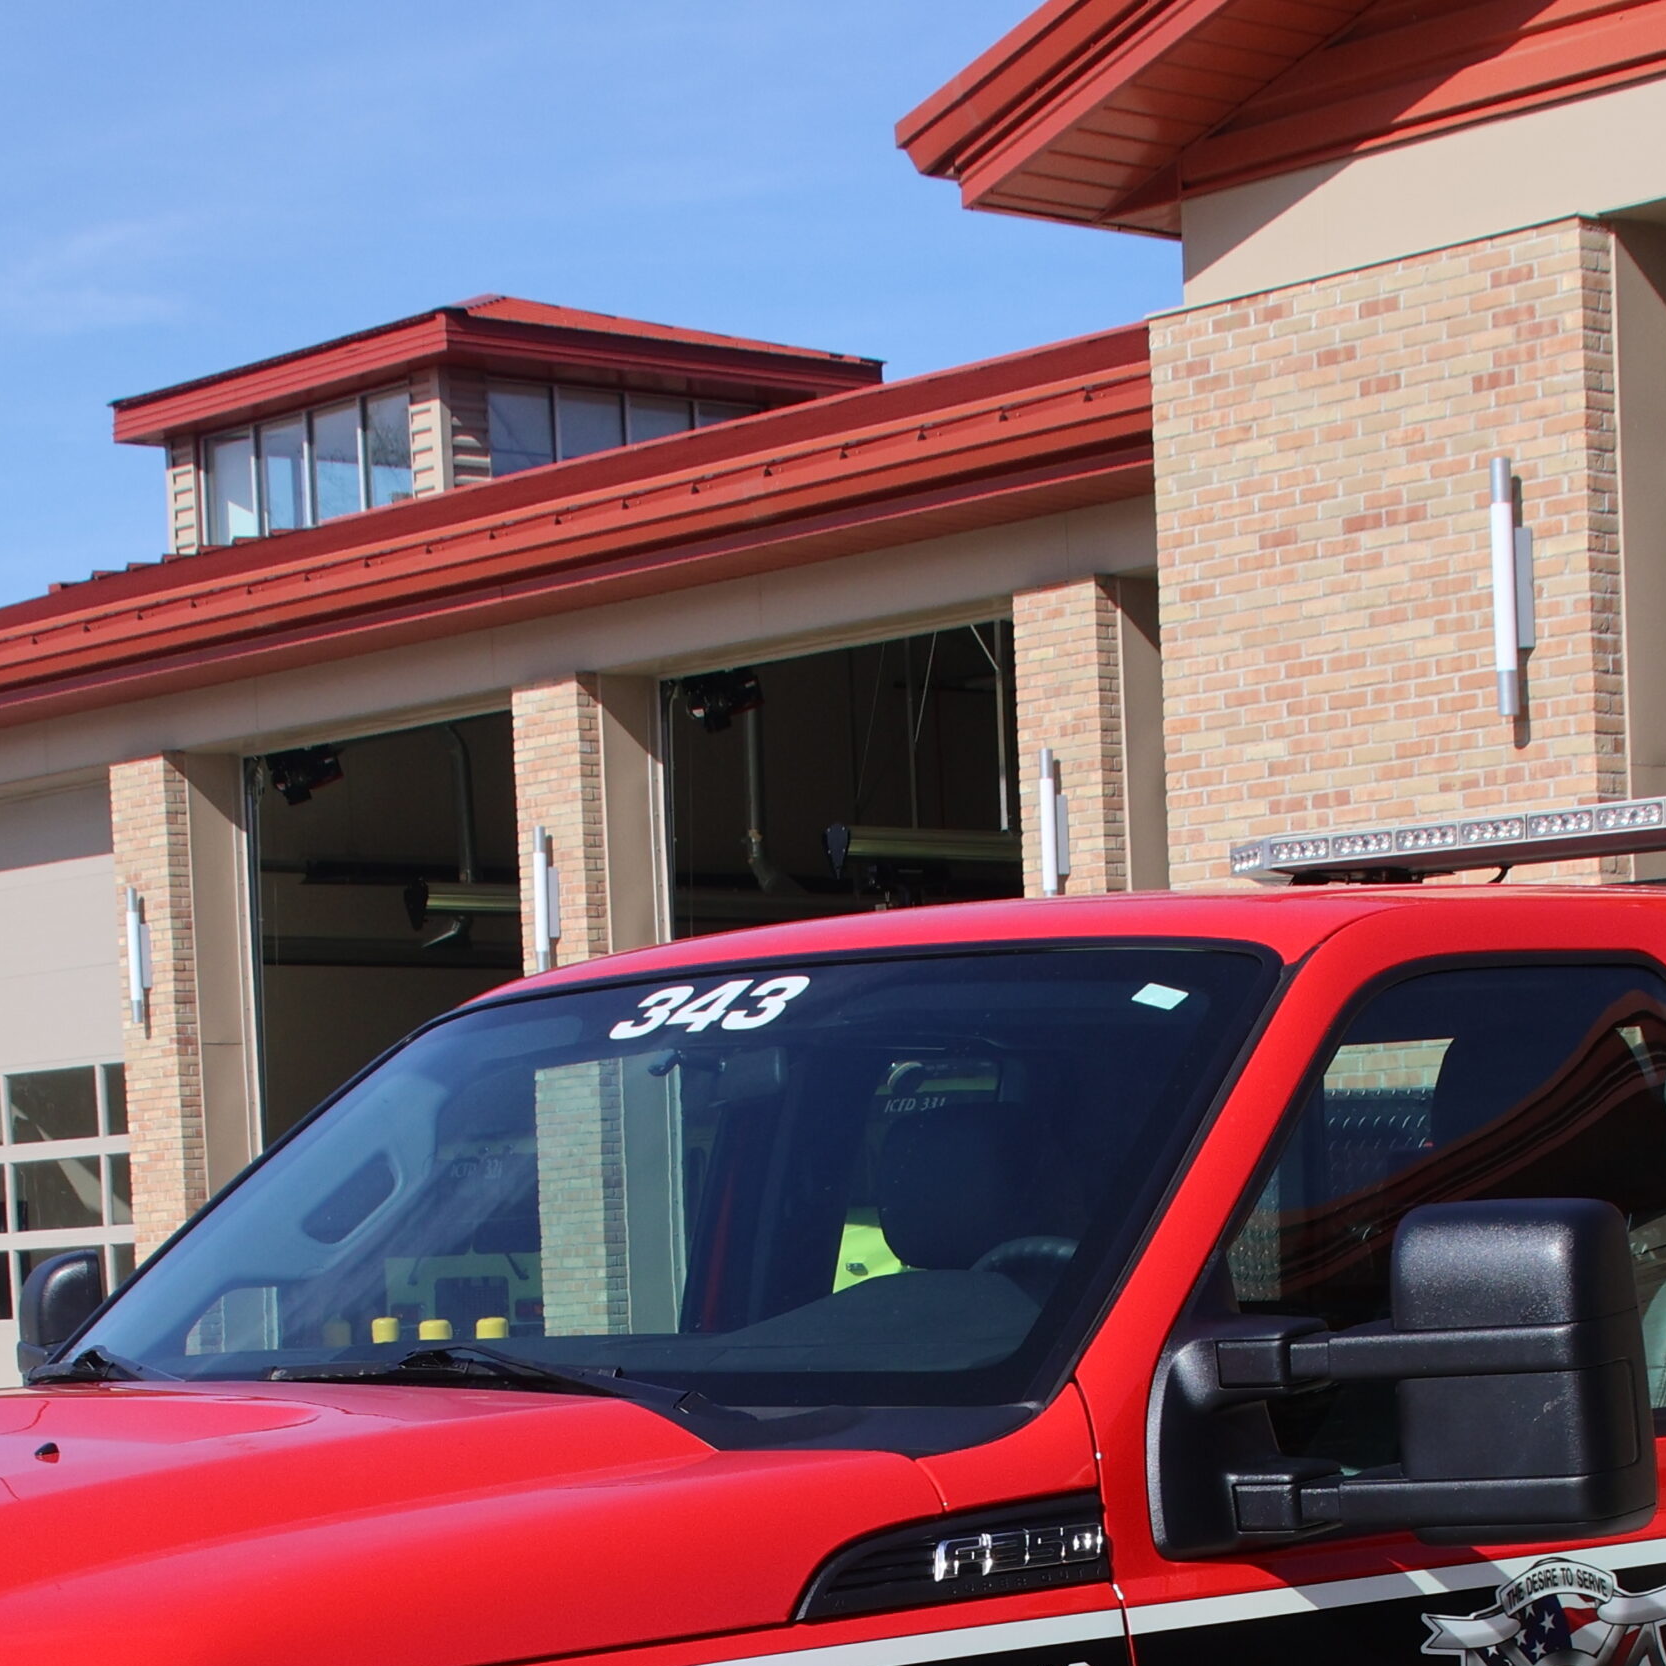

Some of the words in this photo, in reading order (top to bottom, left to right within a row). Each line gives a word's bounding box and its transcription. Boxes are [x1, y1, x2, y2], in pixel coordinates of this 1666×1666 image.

[609, 976, 811, 1040] 343
[1507, 1581, 1524, 1610] THE
[1526, 1567, 1559, 1596] DESIRE
[1560, 1567, 1574, 1586] TO
[1577, 1568, 1608, 1598] SERVE
